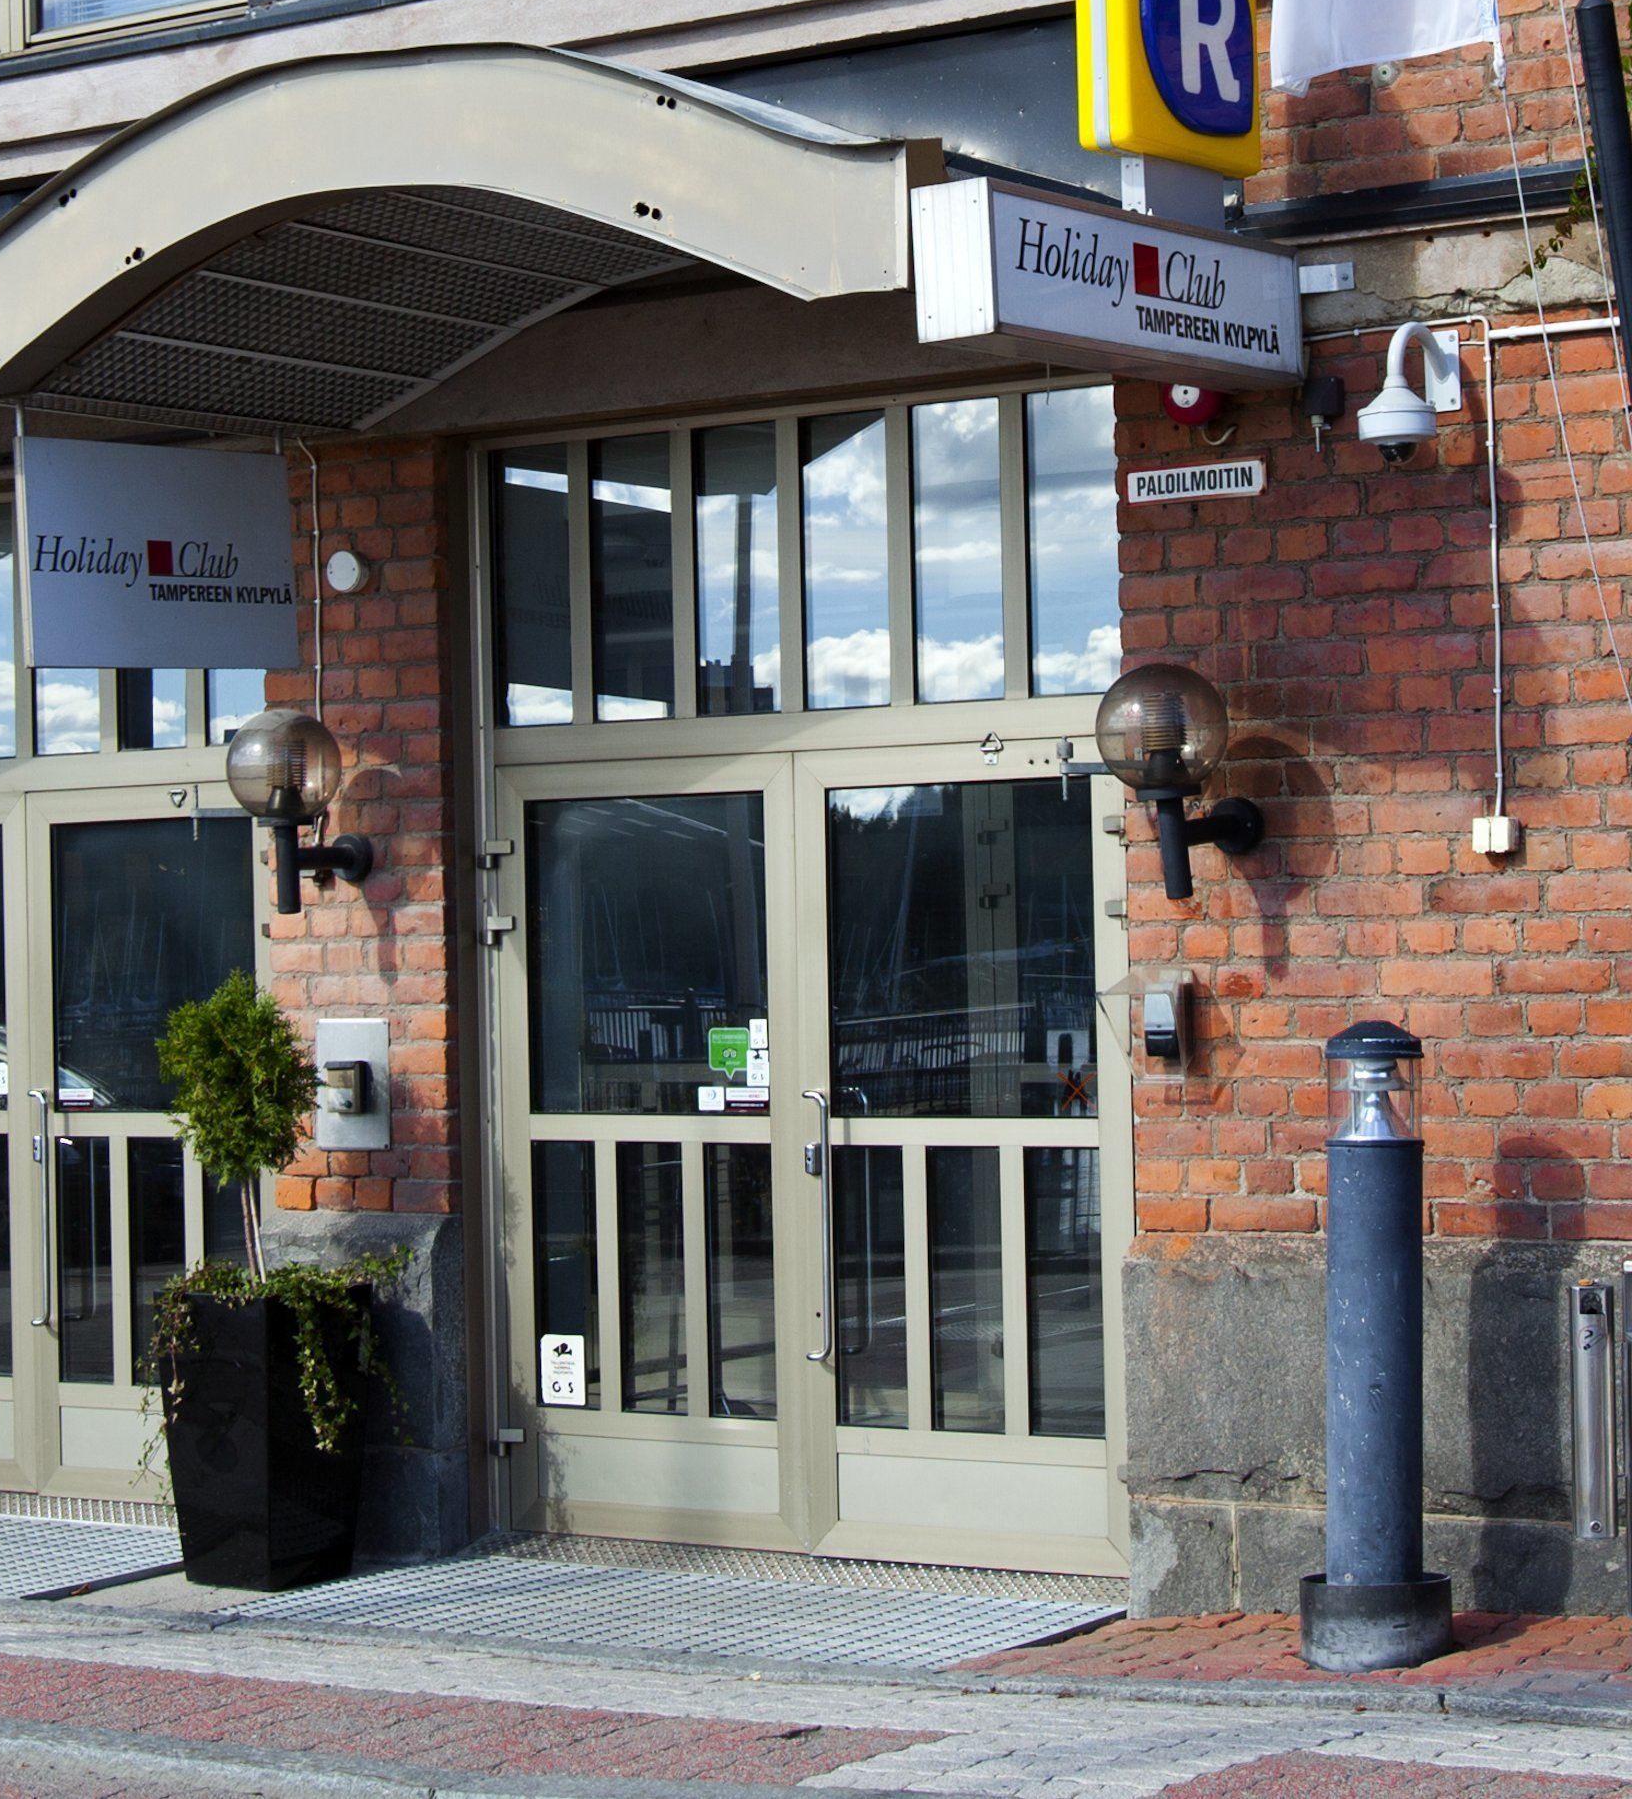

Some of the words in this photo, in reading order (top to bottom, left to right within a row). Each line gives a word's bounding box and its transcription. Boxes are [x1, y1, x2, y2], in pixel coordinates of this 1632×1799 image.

[1015, 217, 1129, 307] Holiday
[1165, 249, 1226, 310] Club
[1135, 305, 1221, 345] TAMPEREEN
[1223, 321, 1281, 356] KYLPYLÄ
[1136, 466, 1254, 499] PALOILMOITIN
[33, 534, 143, 588] Holiday
[178, 540, 239, 579] Club
[149, 583, 233, 603] TAMPEREEN
[236, 583, 293, 605] KYLPYLÄ
